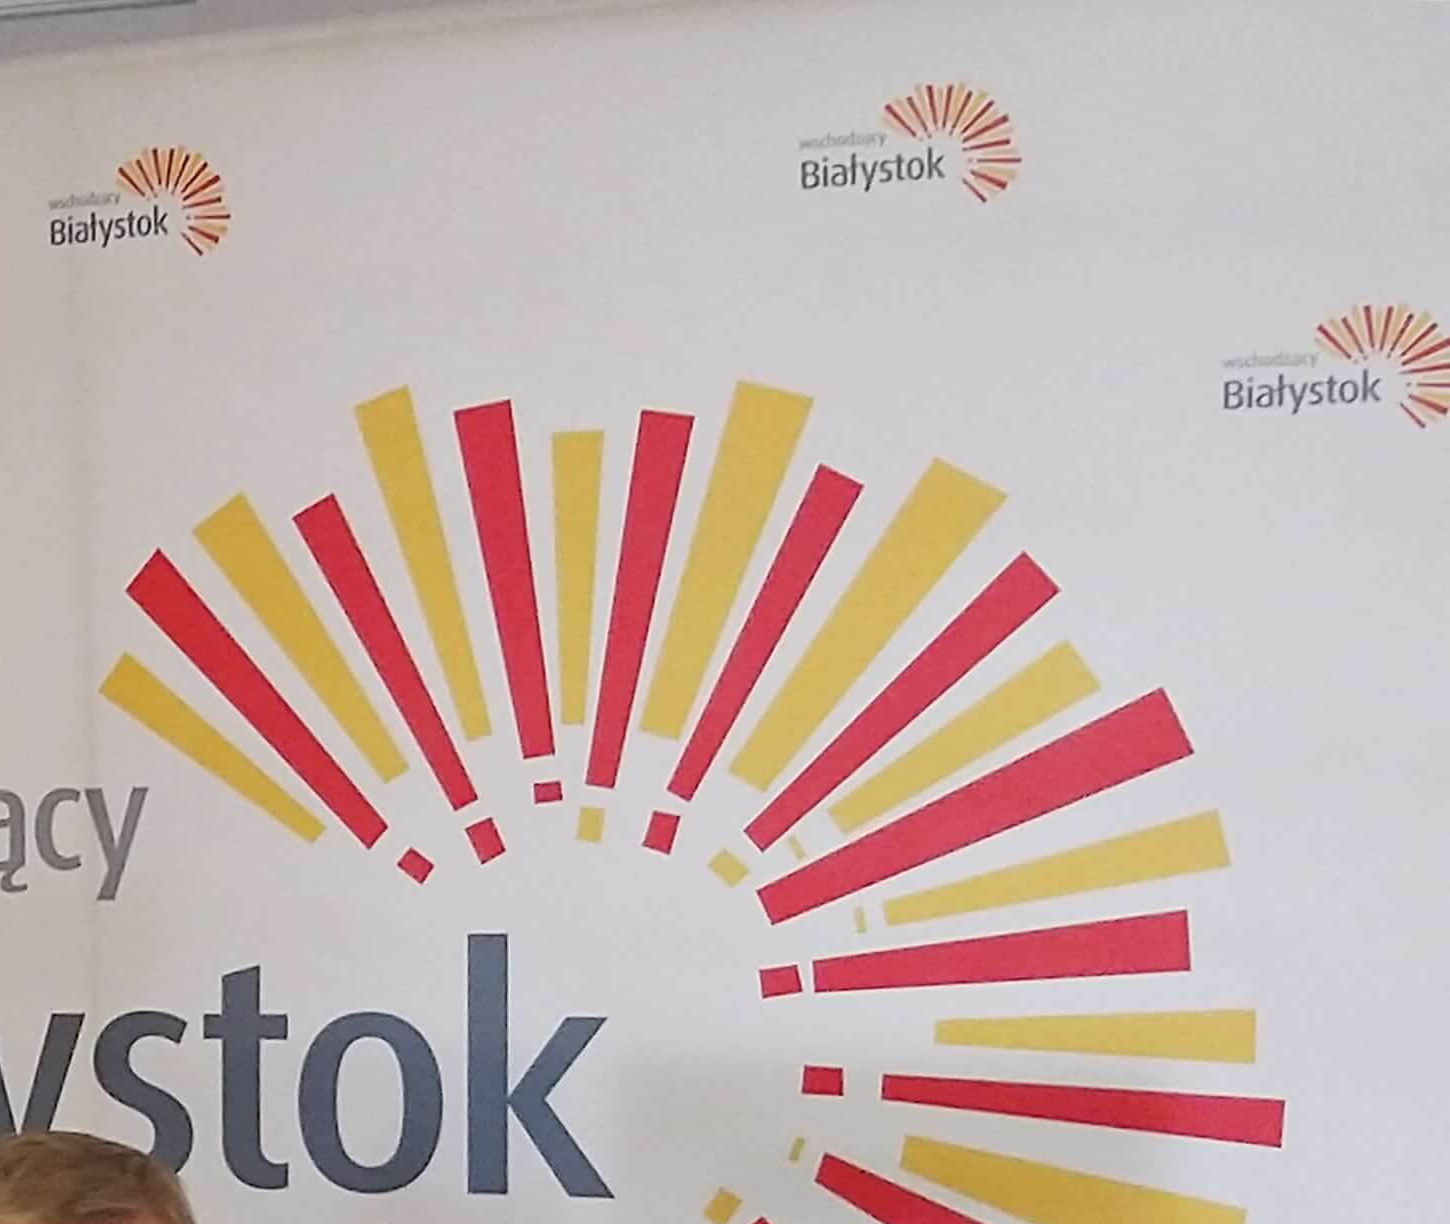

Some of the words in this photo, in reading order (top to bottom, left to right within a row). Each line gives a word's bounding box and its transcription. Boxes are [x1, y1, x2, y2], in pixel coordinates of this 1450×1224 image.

[800, 147, 946, 192] Białystok
[49, 205, 168, 248] Białystok
[1223, 369, 1383, 415] Białystok
